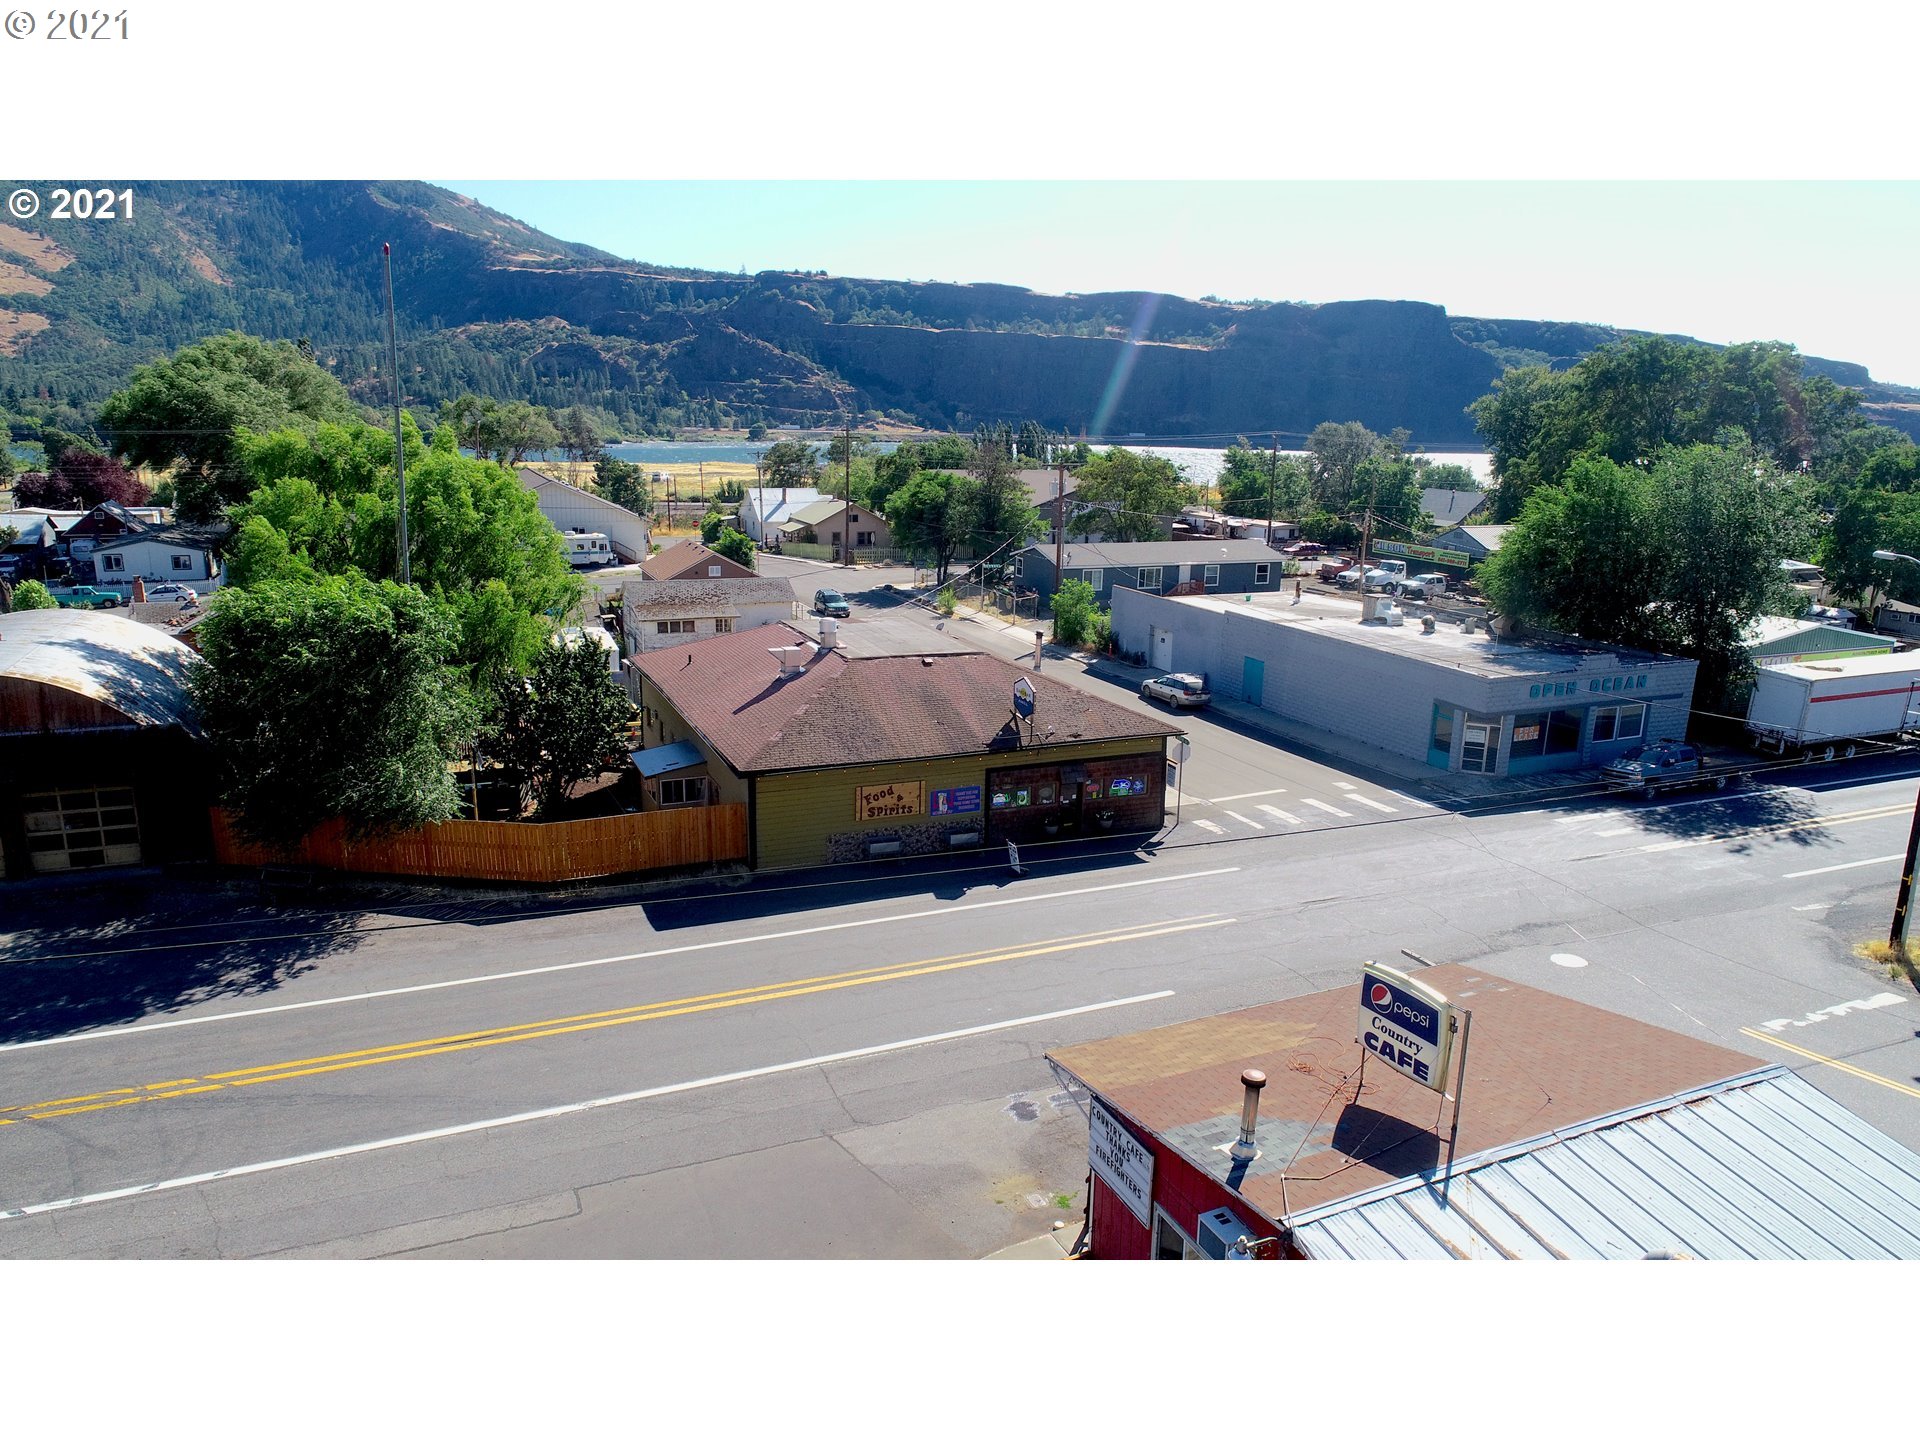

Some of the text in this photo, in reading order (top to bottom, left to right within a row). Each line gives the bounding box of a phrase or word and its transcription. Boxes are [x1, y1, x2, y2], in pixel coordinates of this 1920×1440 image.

[1529, 674, 1647, 698] OPEN OCEAN
[1513, 732, 1539, 741] LEASE
[863, 785, 895, 806] Food
[867, 803, 914, 818] Spirits
[1393, 1002, 1429, 1028] pepsi
[1371, 1016, 1423, 1055] Country
[1363, 1031, 1430, 1082] CAFE
[1092, 1105, 1144, 1164] COUNTRY CAFE
[1105, 1130, 1131, 1163] THANKS
[1109, 1146, 1124, 1168] YOU
[1095, 1144, 1142, 1200] FIREFIGHTERS
